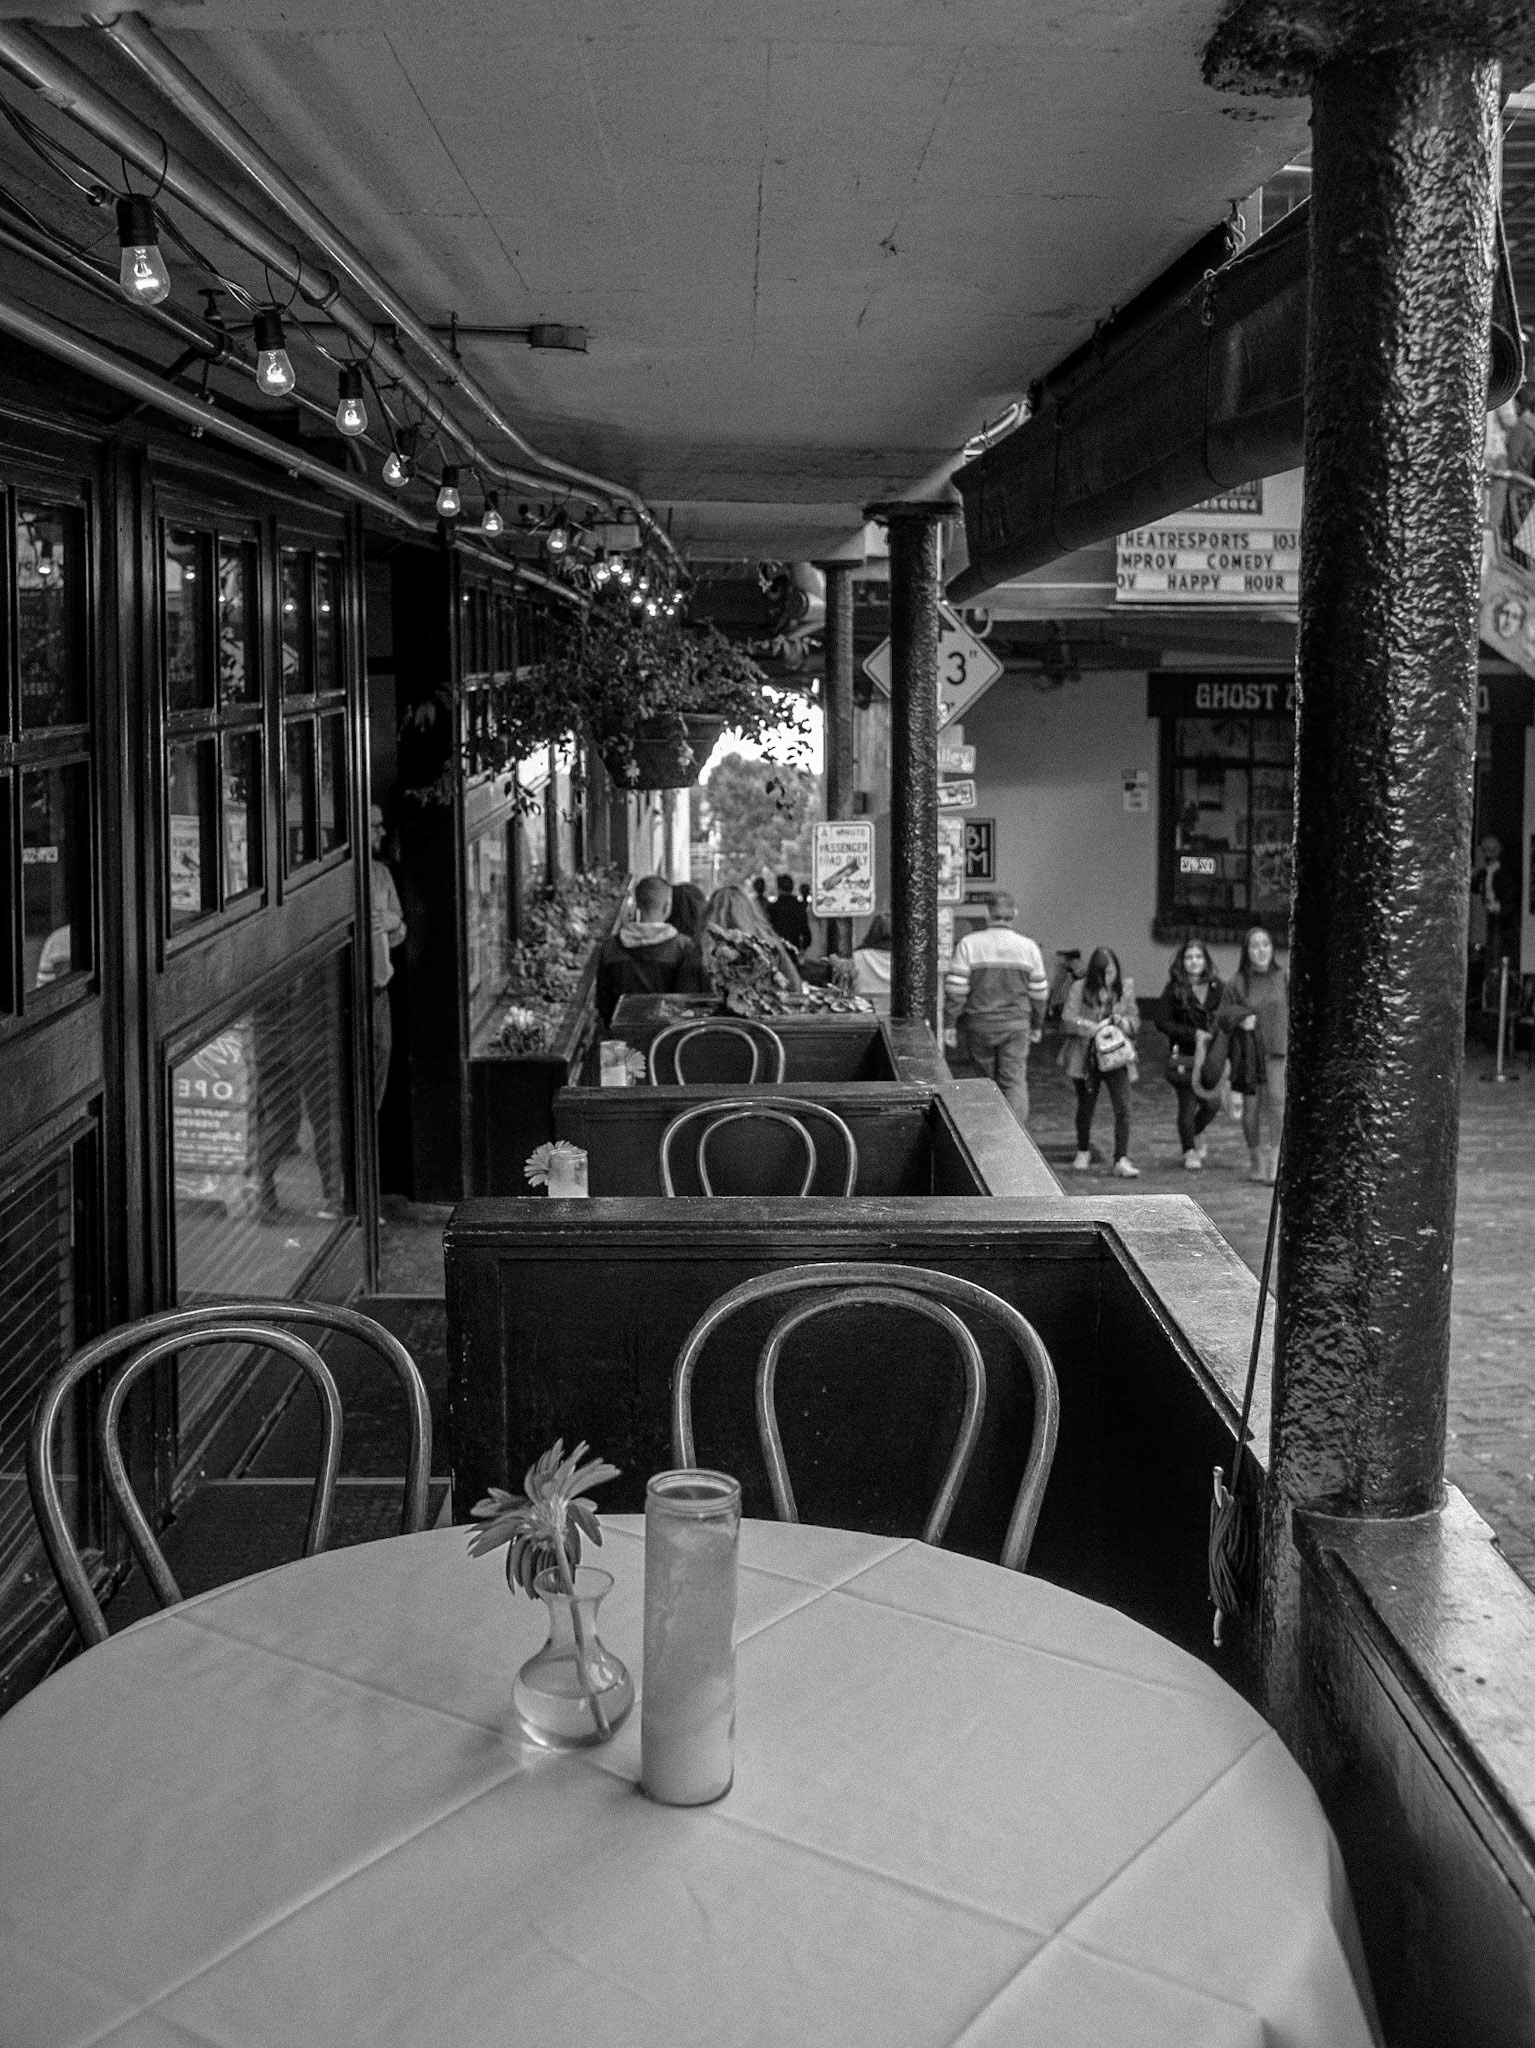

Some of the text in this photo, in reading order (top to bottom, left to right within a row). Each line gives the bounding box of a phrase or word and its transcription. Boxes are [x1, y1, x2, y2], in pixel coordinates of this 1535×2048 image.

[1206, 553, 1273, 569] COMEDY
[1167, 574, 1221, 591] HAPPY
[1244, 575, 1285, 591] HOUR
[1195, 683, 1279, 710] GHOST
[818, 842, 868, 853] PASSENGER
